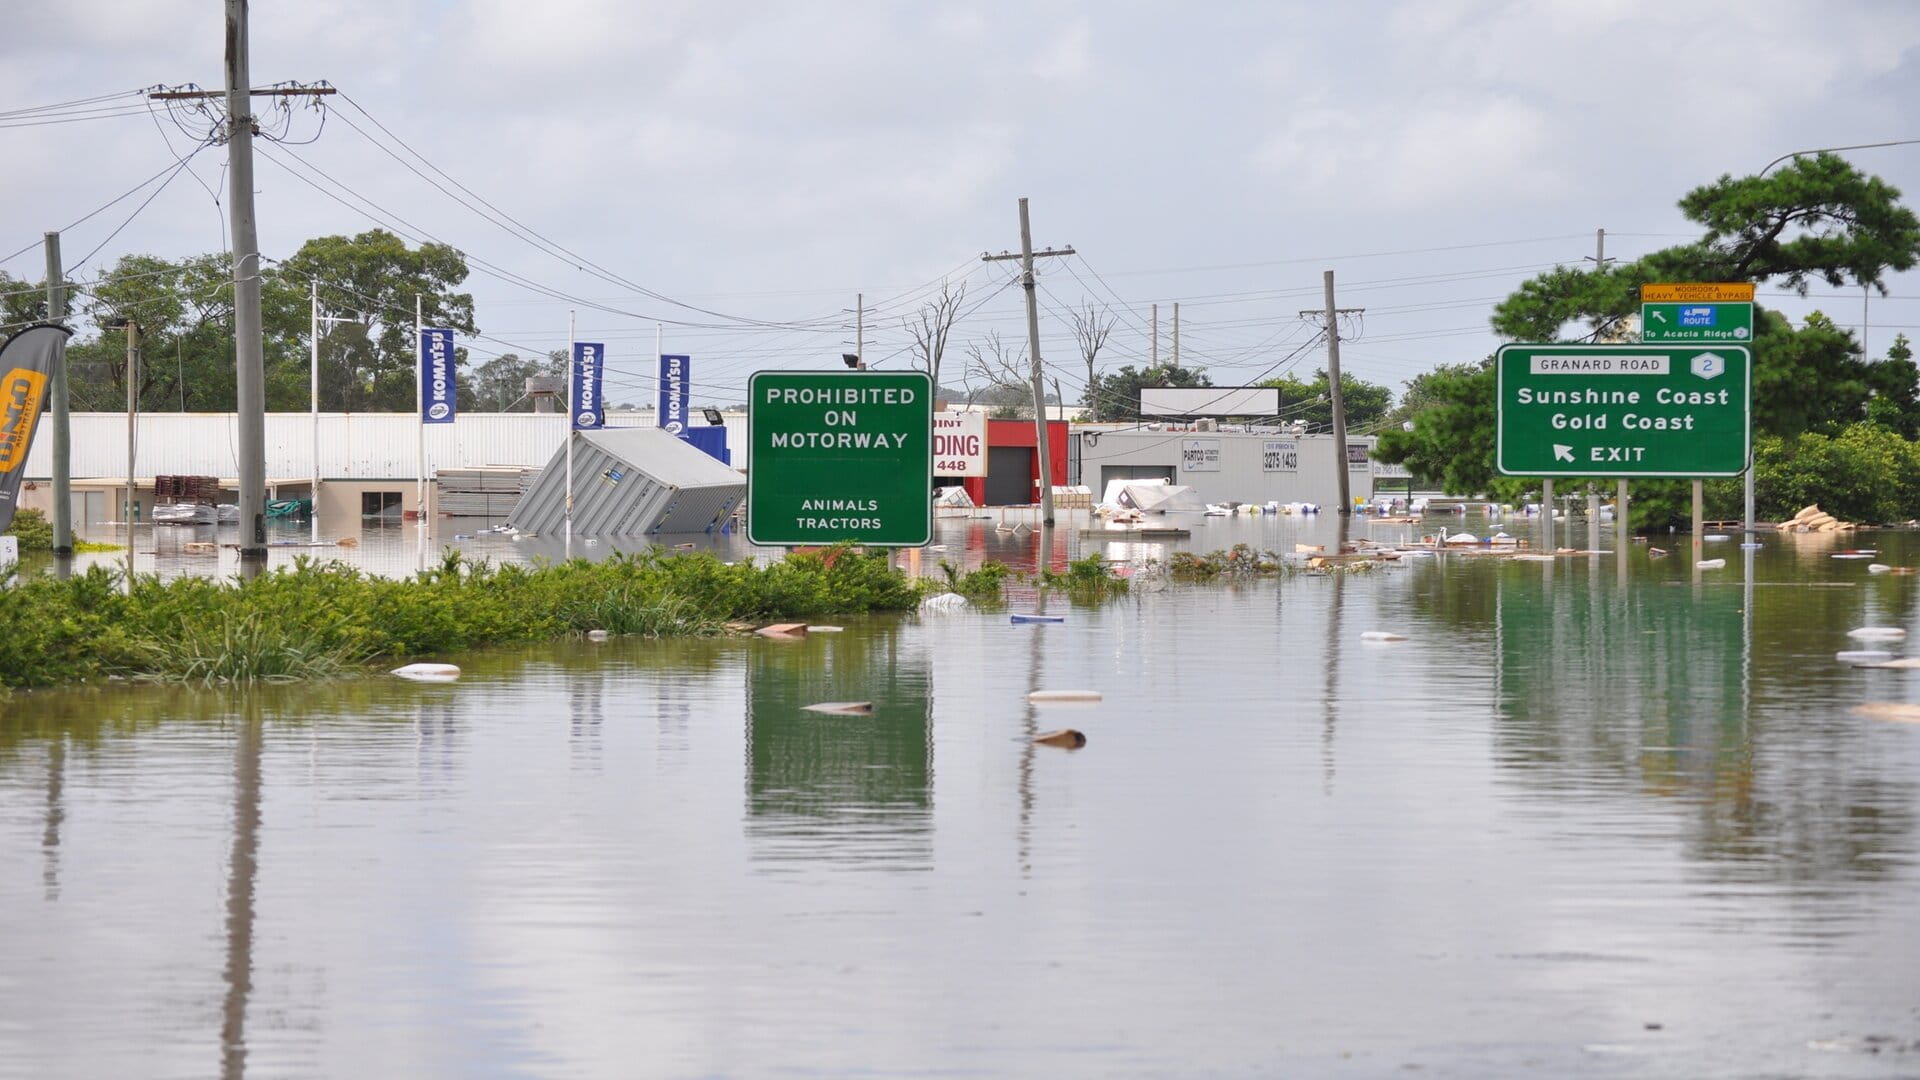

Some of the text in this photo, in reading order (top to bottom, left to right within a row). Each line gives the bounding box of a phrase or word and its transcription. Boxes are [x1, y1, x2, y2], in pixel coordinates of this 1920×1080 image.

[1683, 317, 1711, 325] ROUTE
[1645, 330, 1656, 338] To
[1663, 330, 1698, 338] Acacia
[1704, 330, 1733, 339] Ridge
[429, 332, 446, 400] KOMATSU
[1540, 359, 1660, 370] GRANARD ROAD
[1703, 359, 1713, 371] 2
[581, 346, 595, 410] KOMATSU
[667, 358, 681, 420] KOMATSU
[767, 388, 915, 404] PROHIBITED
[1517, 388, 1729, 405] Sunshine Coast
[16, 396, 34, 448] AUSTRALIA
[824, 410, 856, 426] ON
[1551, 413, 1694, 430] Gold Coast
[771, 433, 908, 448] MOTORWAY
[1184, 449, 1204, 461] PARTCO
[1264, 452, 1297, 469] 3275 1433
[1591, 447, 1646, 461] EXIT
[937, 460, 967, 471] 448
[801, 499, 878, 511] ANIMALS
[797, 517, 882, 529] TRACTORS
